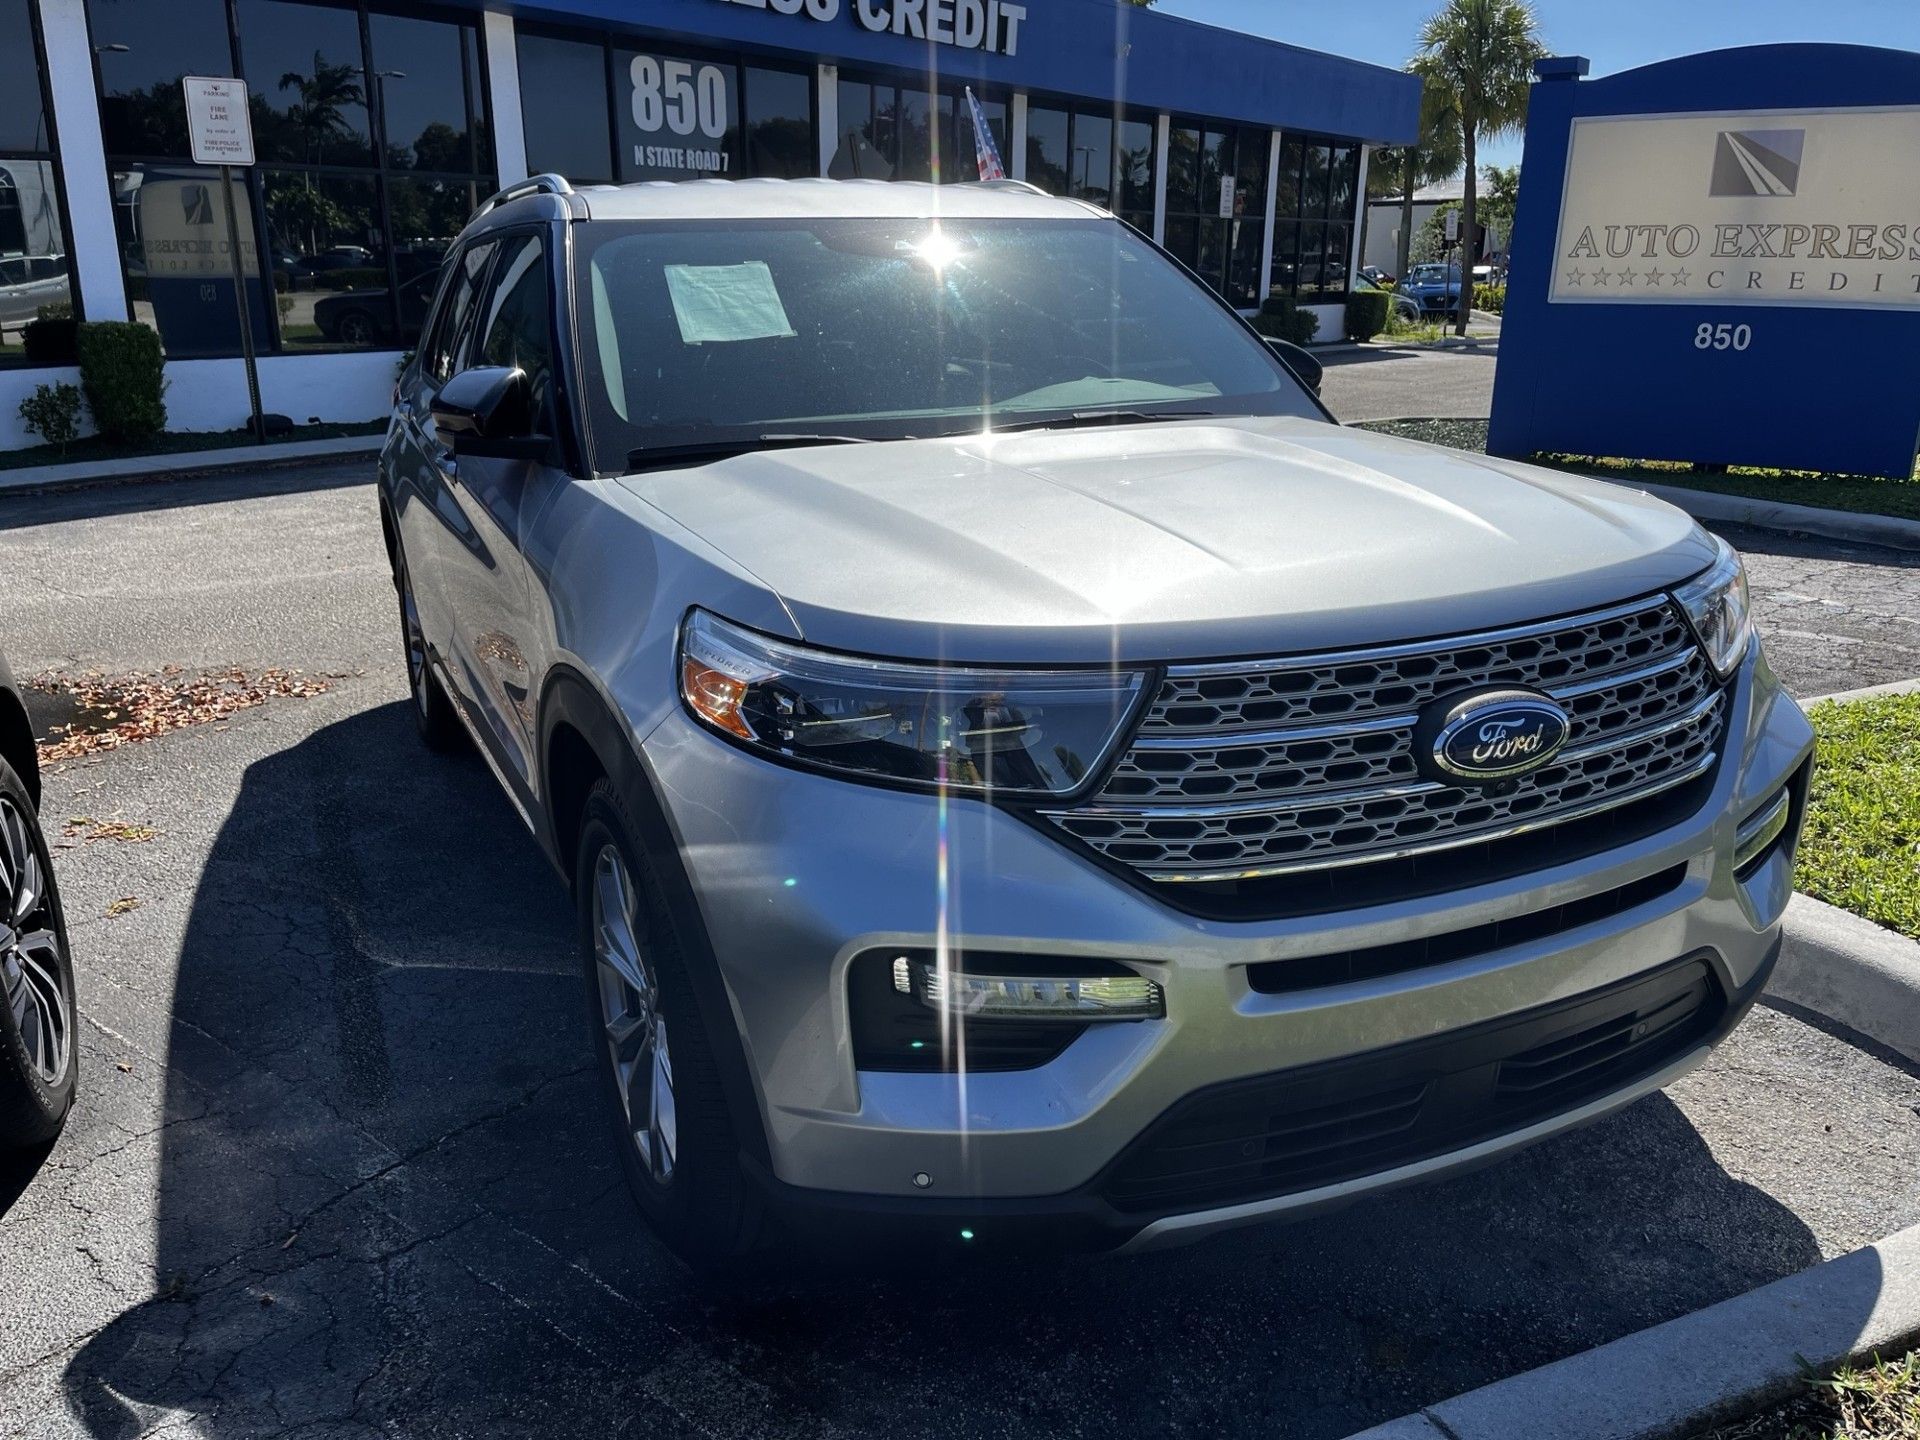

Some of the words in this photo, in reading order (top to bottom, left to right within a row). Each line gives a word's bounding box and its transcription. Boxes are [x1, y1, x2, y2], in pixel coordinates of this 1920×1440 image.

[857, 0, 1026, 56] CREDIT
[630, 55, 727, 138] 850
[634, 145, 644, 166] N
[646, 146, 684, 170] STATE
[686, 149, 720, 172] ROAD
[721, 152, 729, 172] 7
[1568, 224, 1700, 258] AUTO
[1707, 271, 1920, 294] CREDIT
[1694, 323, 1752, 351] 850
[1472, 717, 1544, 763] Ford
